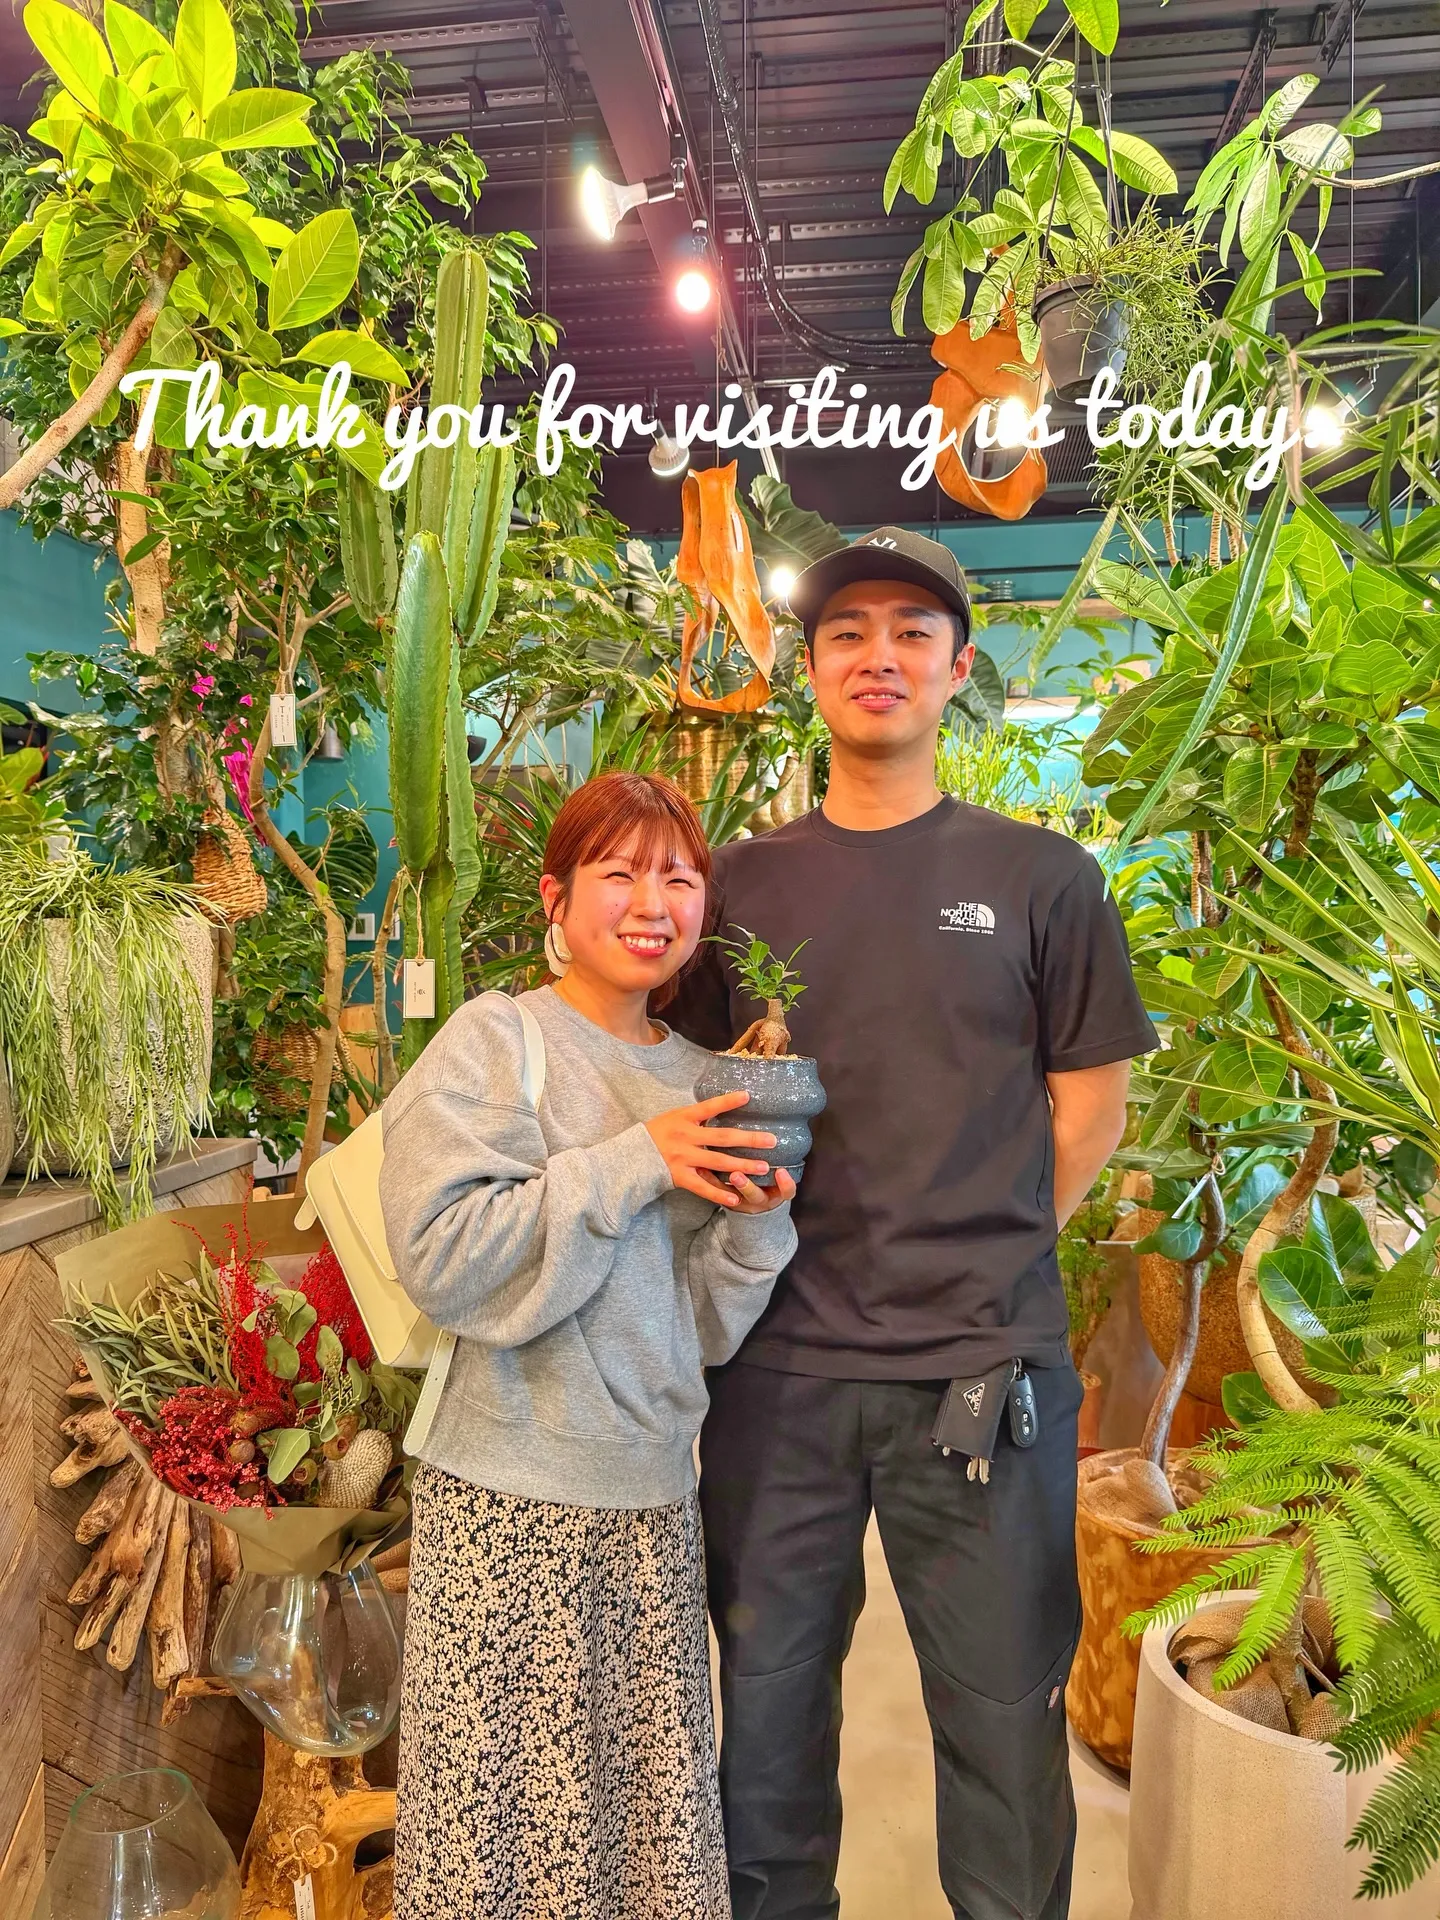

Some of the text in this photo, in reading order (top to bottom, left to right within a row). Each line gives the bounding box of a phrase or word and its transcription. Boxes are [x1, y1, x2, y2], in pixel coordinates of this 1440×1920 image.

[957, 902, 977, 911] THE
[940, 908, 977, 920] NORTH
[950, 917, 976, 926] FACE
